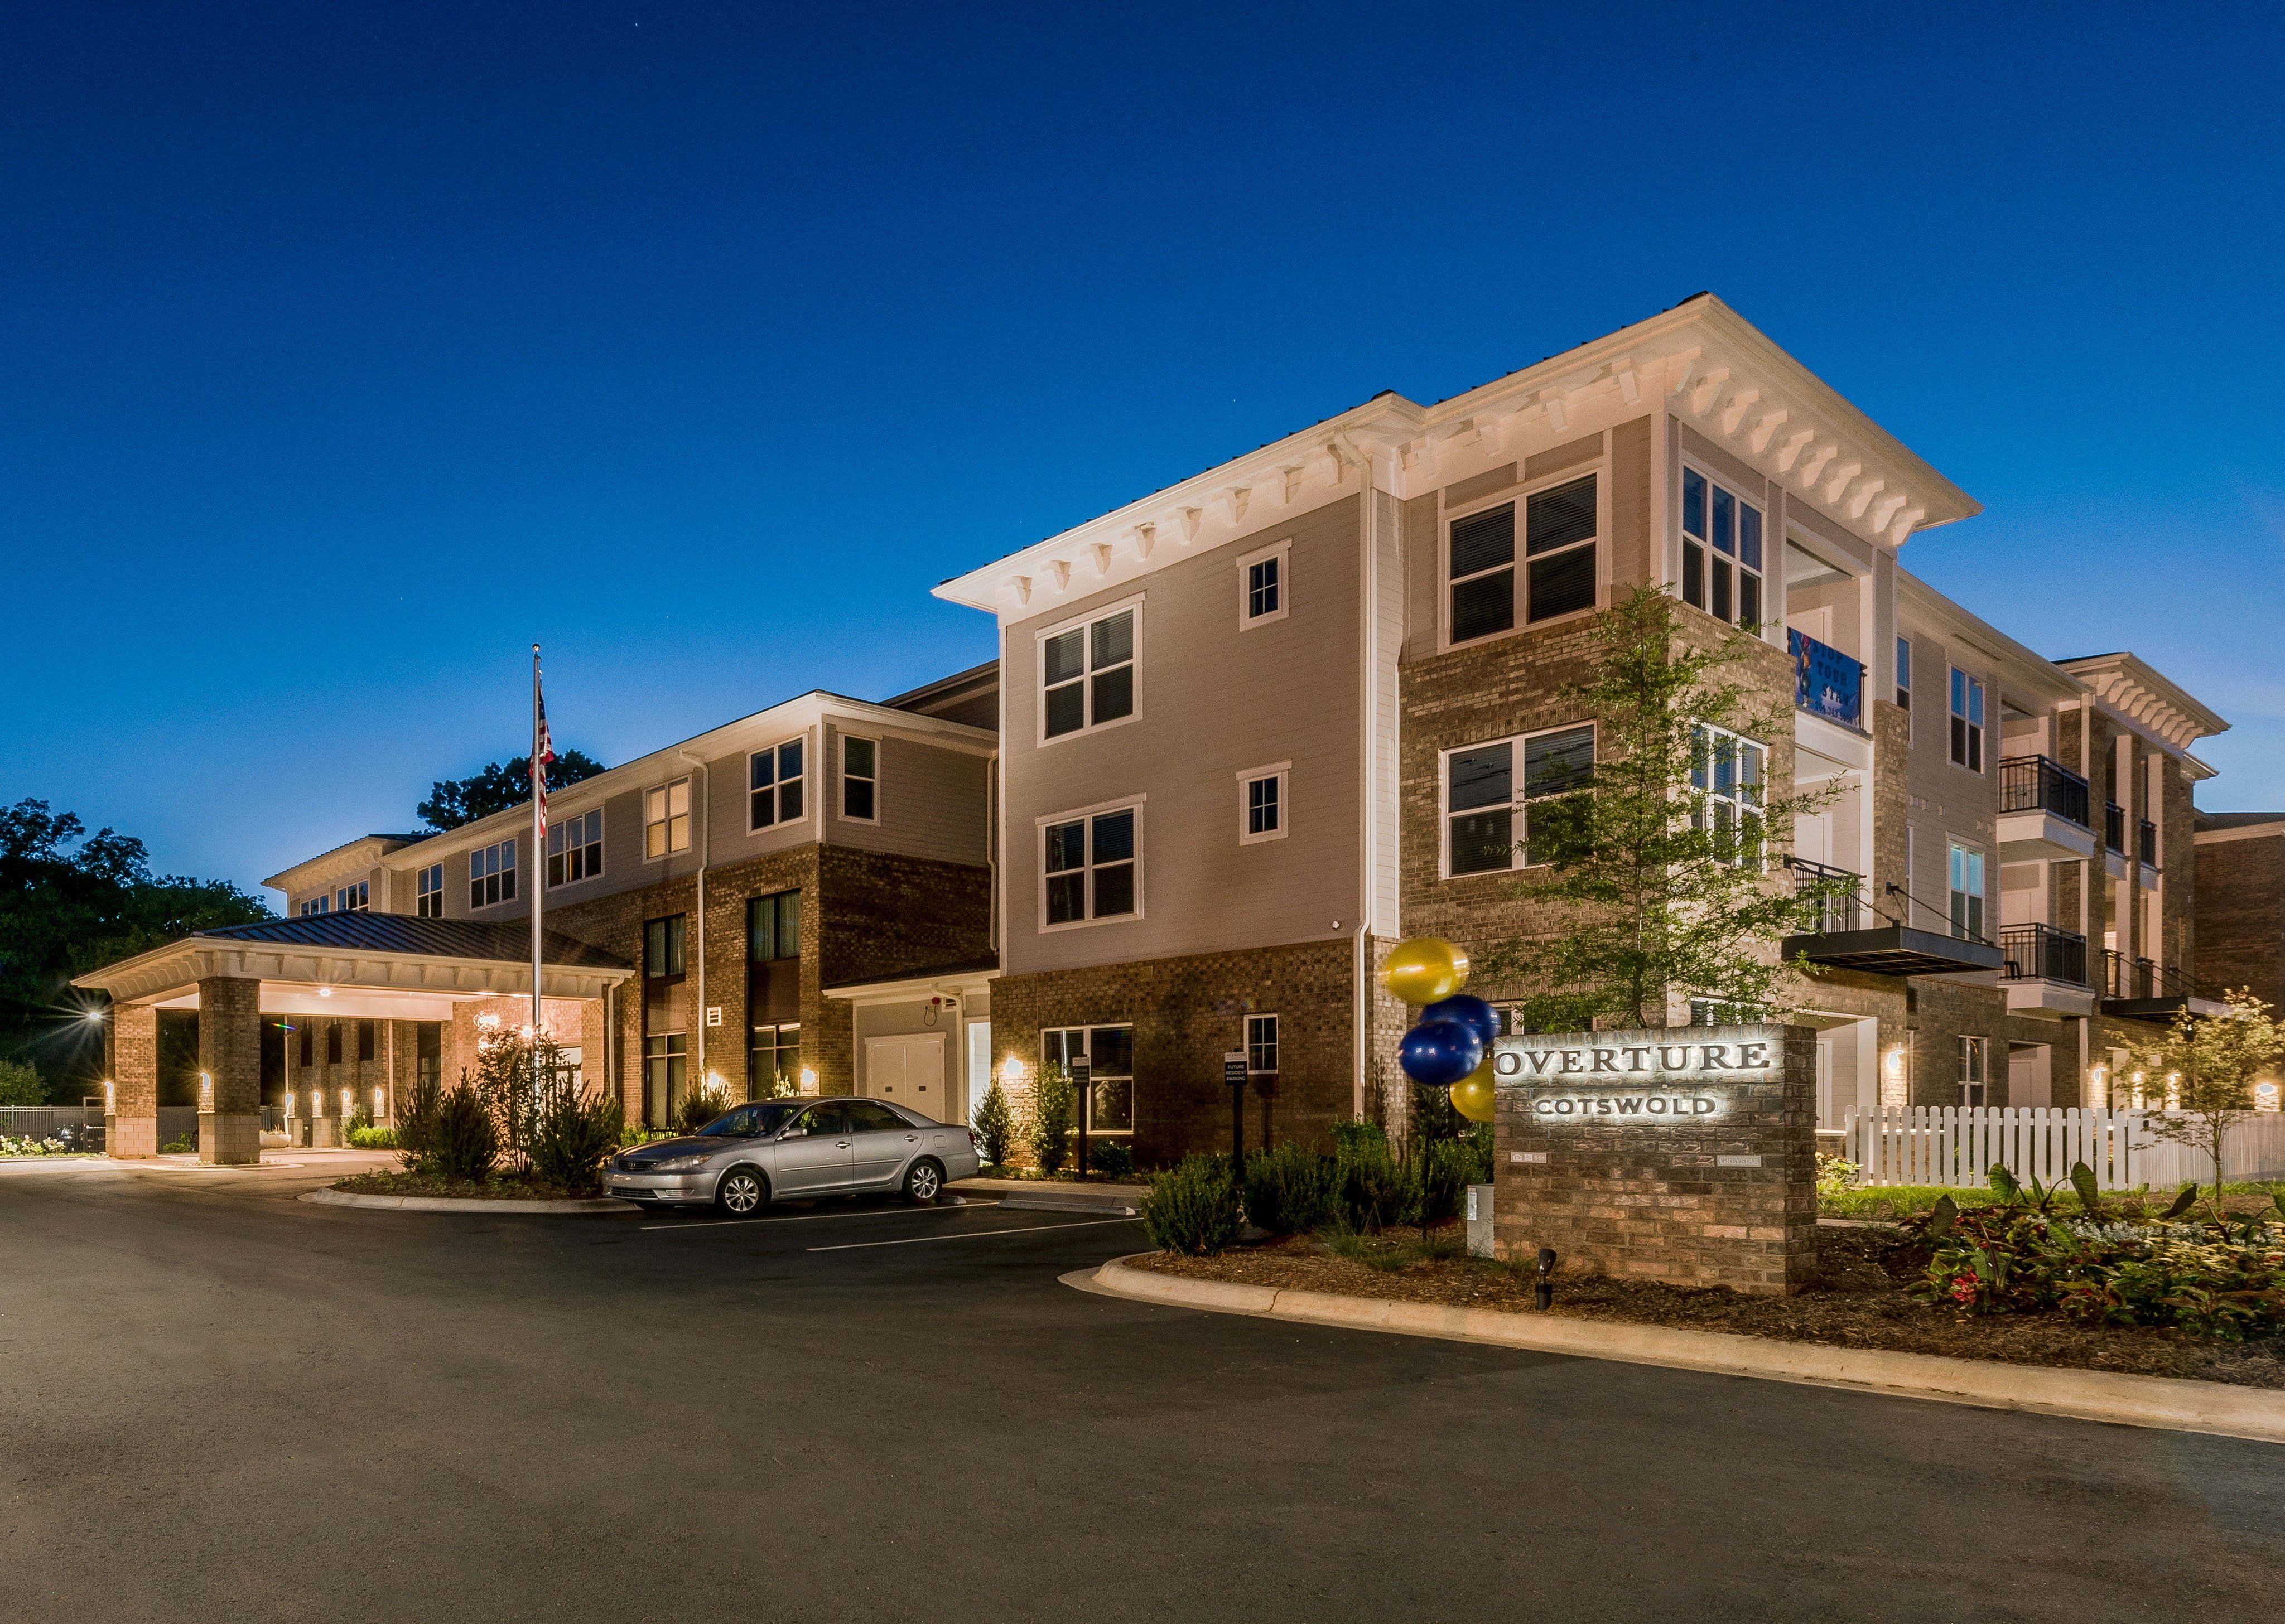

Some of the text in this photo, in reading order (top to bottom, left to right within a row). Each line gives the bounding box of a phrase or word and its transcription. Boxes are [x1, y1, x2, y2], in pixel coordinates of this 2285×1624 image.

[1817, 661, 1847, 687] TOUR
[1823, 683, 1849, 706] STAY
[1493, 1043, 1770, 1075] OVERTURE
[1535, 1097, 1716, 1115] COTSWOLD
[1719, 1157, 1758, 1165] GREYSTAR
